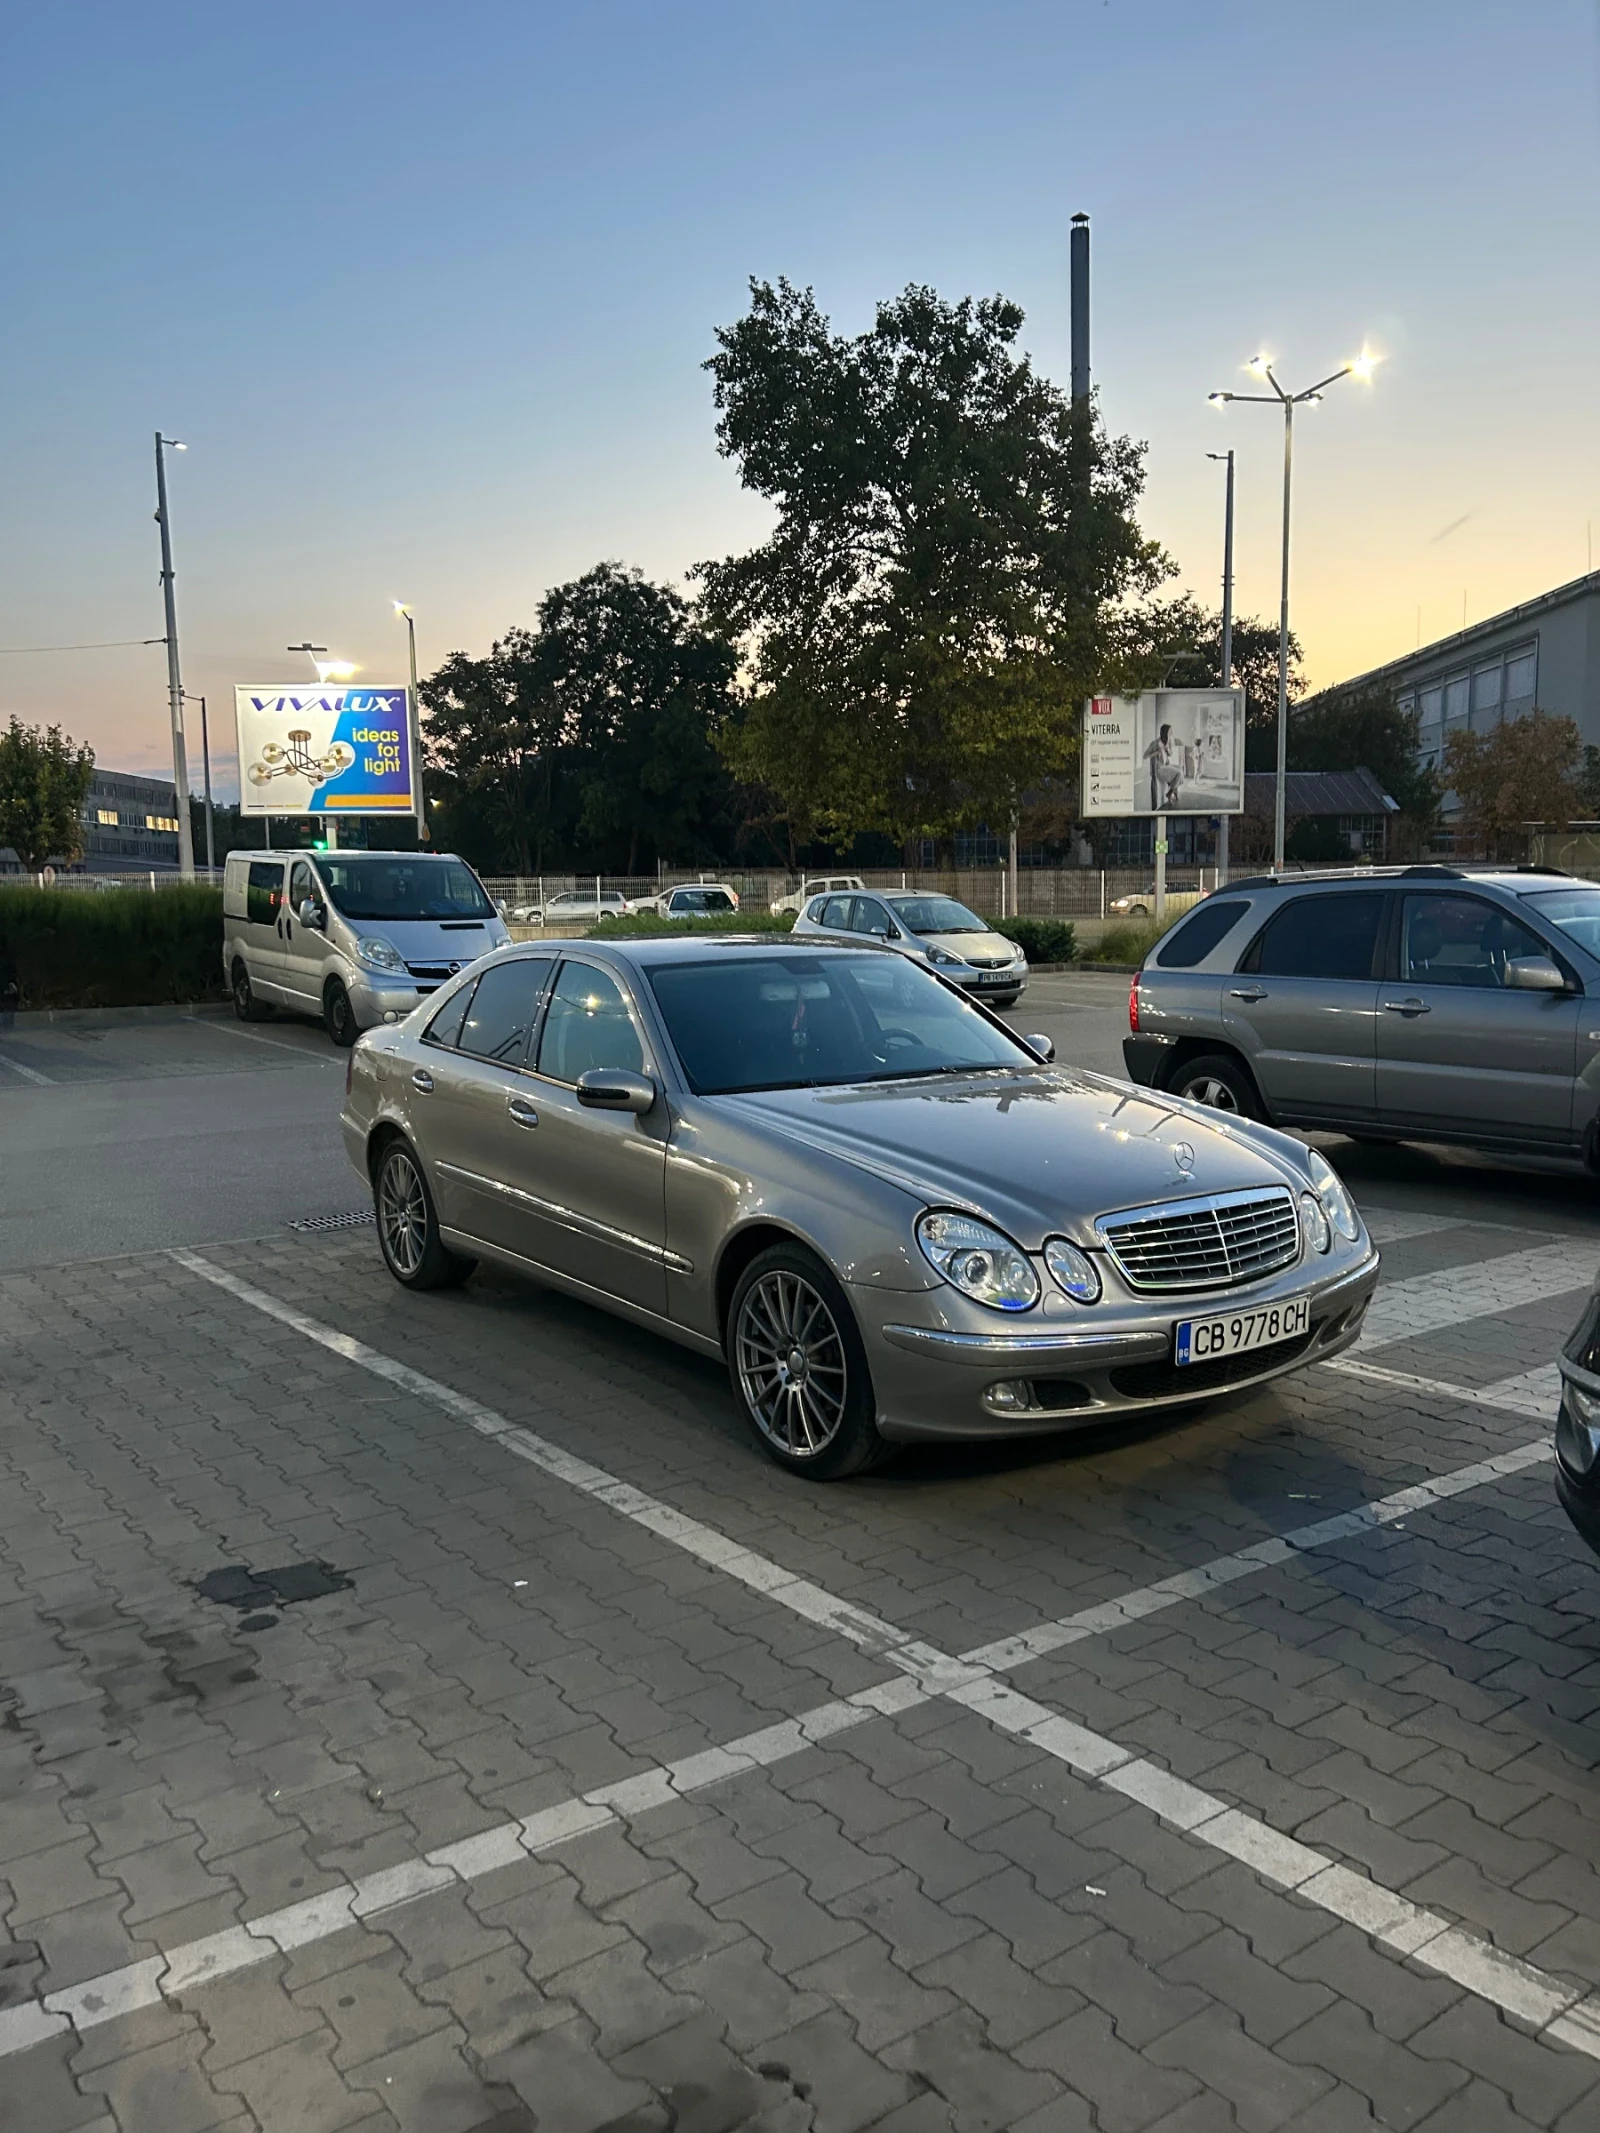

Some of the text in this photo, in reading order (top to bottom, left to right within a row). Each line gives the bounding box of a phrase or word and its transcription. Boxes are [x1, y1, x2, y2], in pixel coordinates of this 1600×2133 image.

[251, 697, 396, 712] VIVALUX
[1097, 700, 1111, 714] VOX
[352, 728, 399, 742] ideas
[1091, 724, 1121, 735] VITERRA
[377, 743, 399, 757] for
[364, 758, 400, 775] light
[1195, 1301, 1308, 1355] CB 9778 CH
[1178, 1348, 1189, 1359] BG
